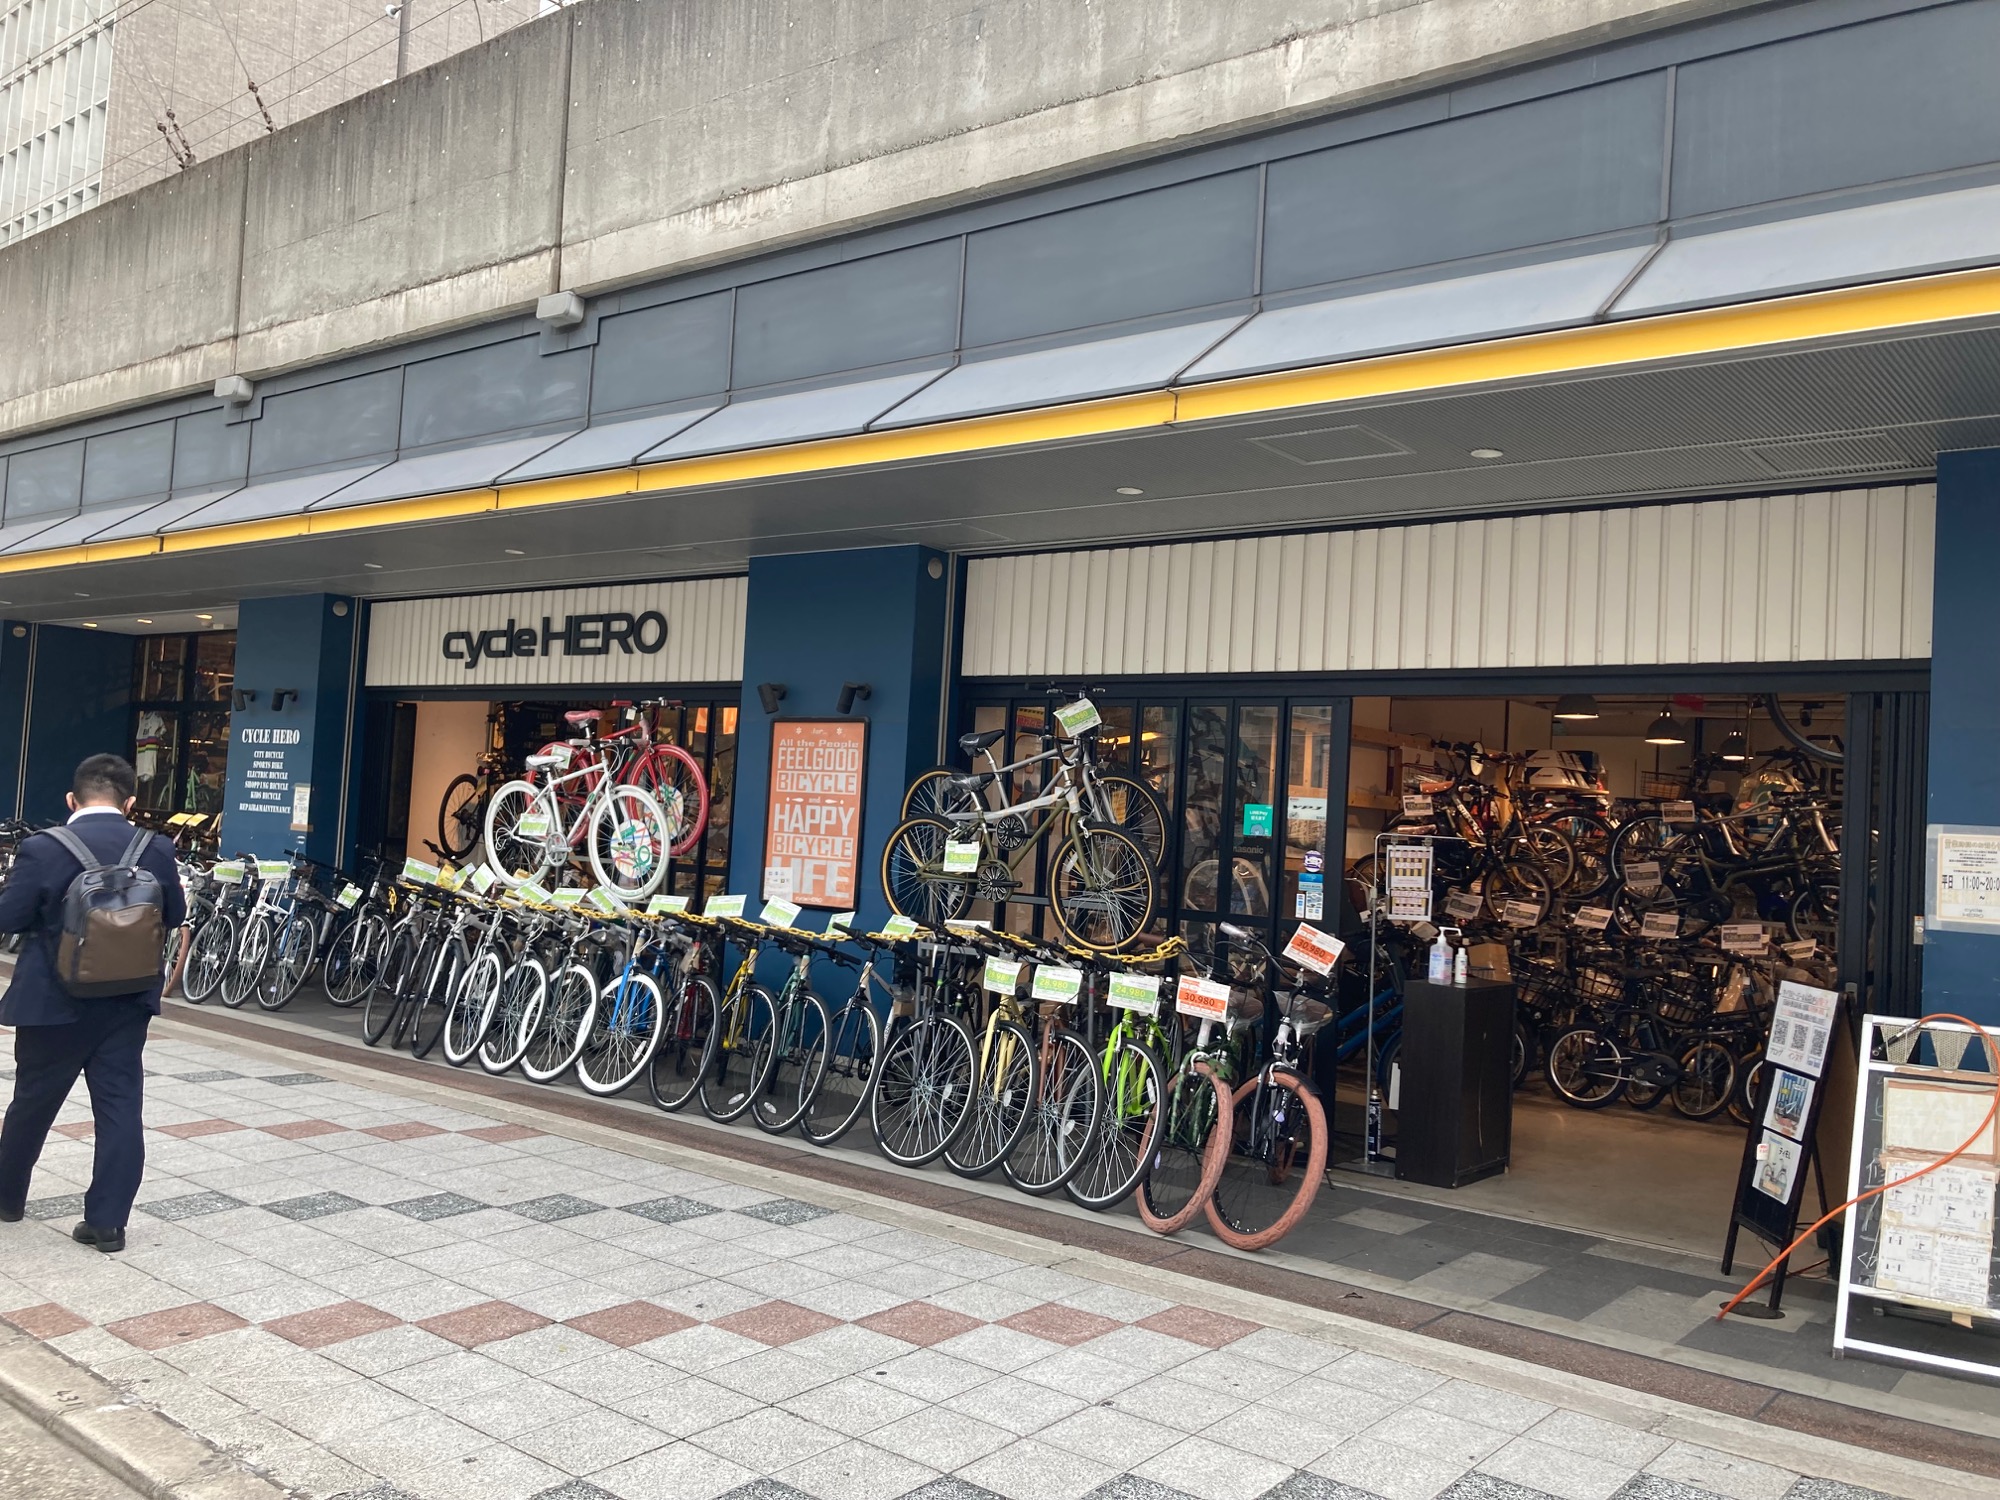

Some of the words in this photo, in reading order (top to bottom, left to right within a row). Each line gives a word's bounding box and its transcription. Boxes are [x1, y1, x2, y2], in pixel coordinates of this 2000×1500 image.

[241, 728, 271, 744] CYCLE
[272, 729, 301, 745] HERO
[779, 739, 794, 747] All
[797, 739, 815, 747] the
[818, 739, 859, 750] People
[253, 750, 264, 759] CITY
[265, 751, 285, 759] BICYCLE
[777, 746, 859, 772] FEELGOOD
[252, 760, 271, 770] SPORTS
[271, 761, 283, 770] BIKE
[246, 770, 269, 779] ELECTRIC
[269, 771, 288, 780] BICYCLE
[244, 780, 270, 790] SHOPPING
[270, 781, 289, 791] BICYCLE
[776, 771, 856, 794] BICYCLE
[250, 790, 262, 800] KIDS
[262, 791, 282, 801] BICYCLE
[773, 803, 856, 836] HAPPY
[773, 834, 852, 859] BICYCLE
[1941, 874, 1954, 889] 平日
